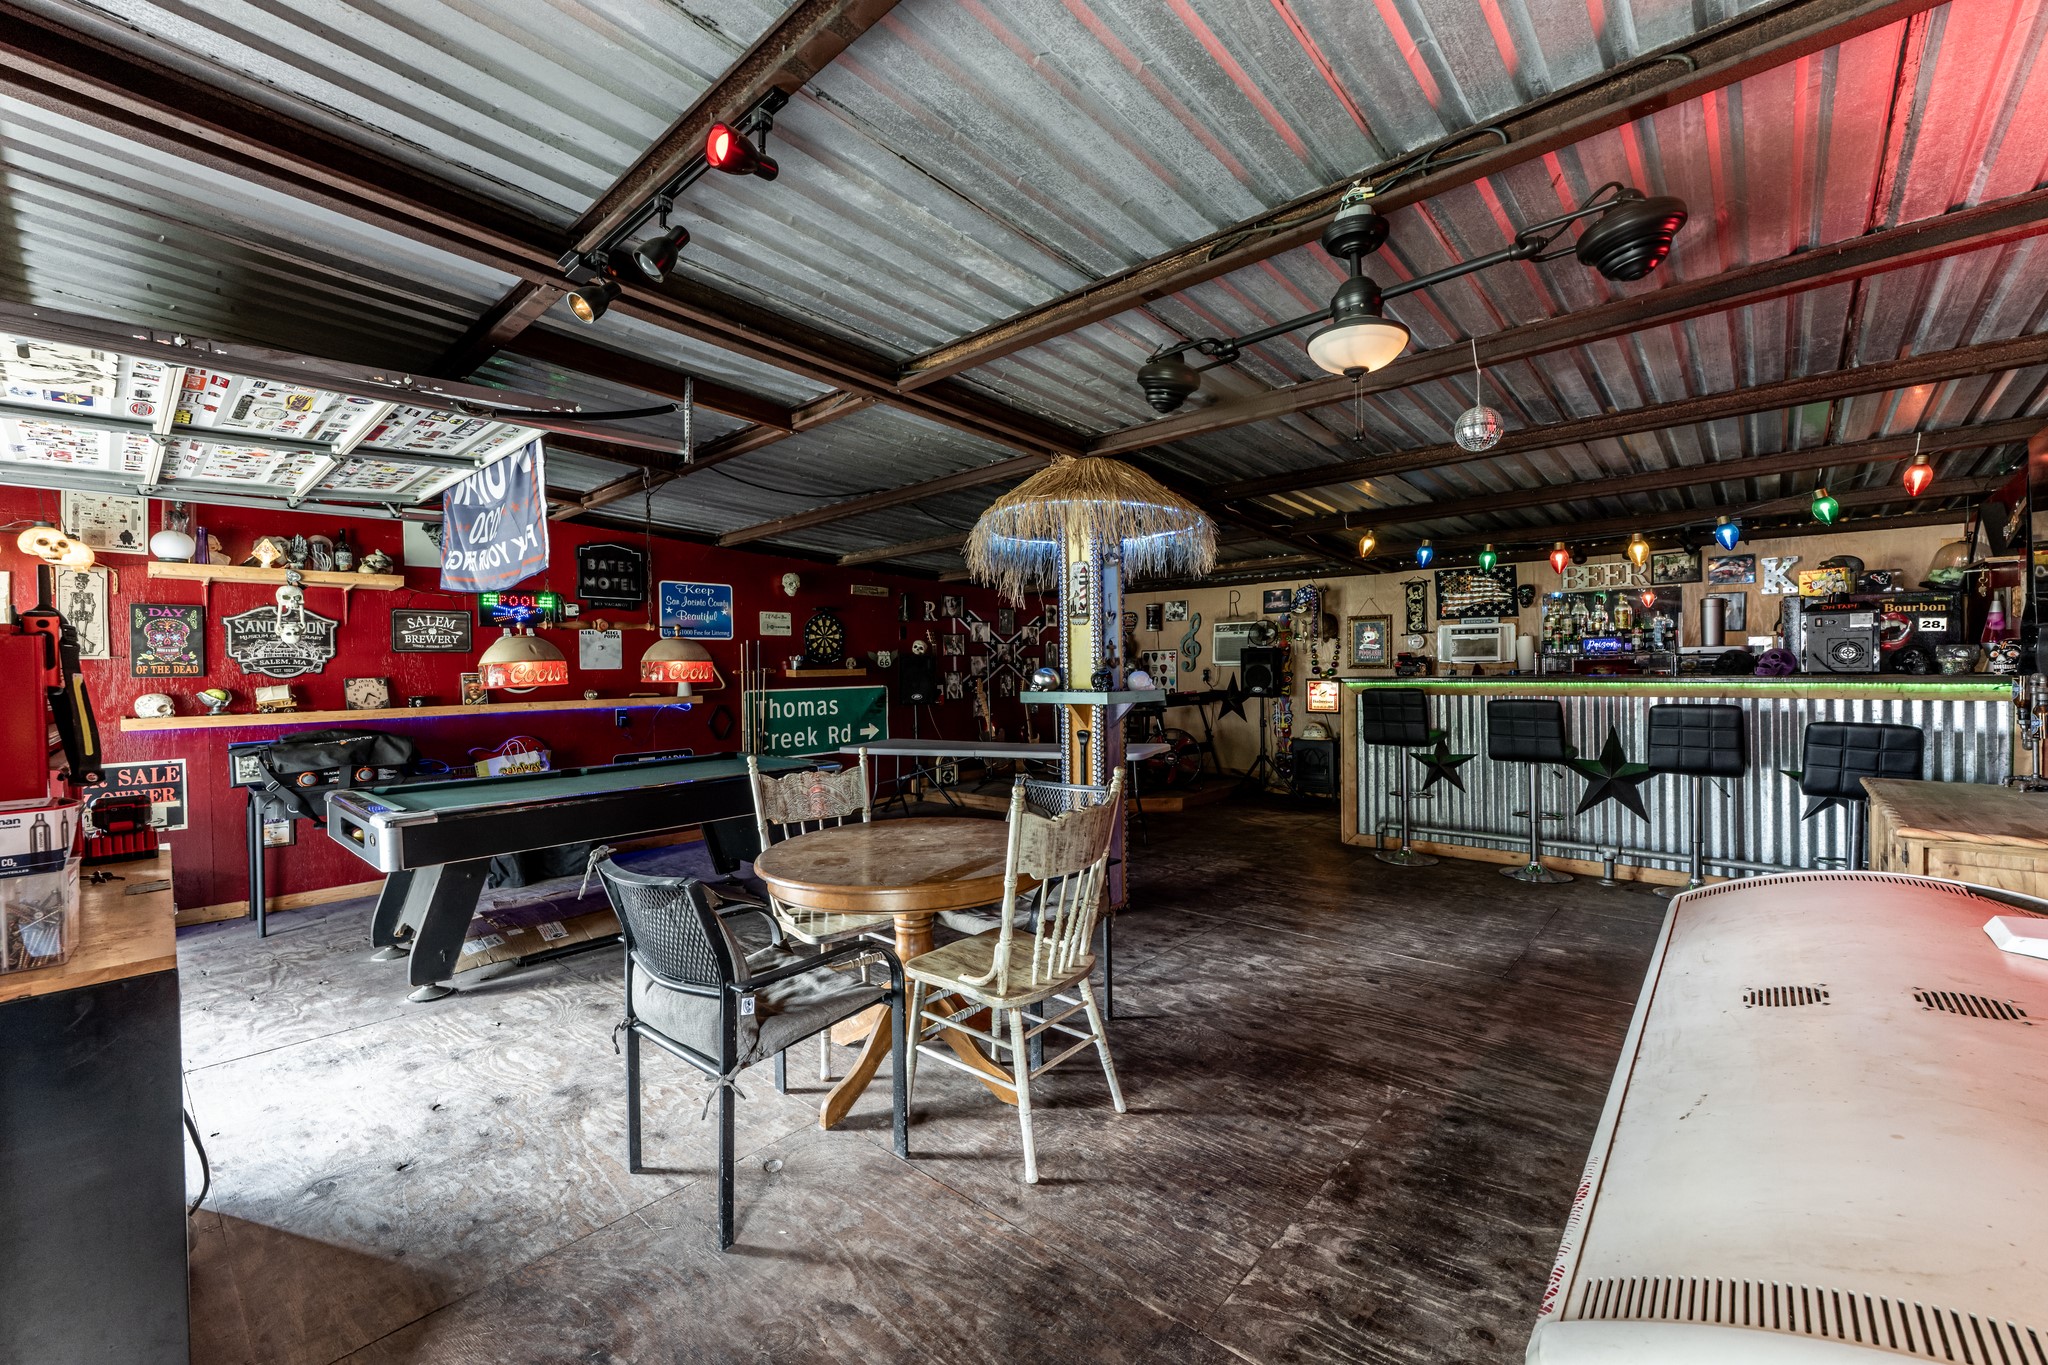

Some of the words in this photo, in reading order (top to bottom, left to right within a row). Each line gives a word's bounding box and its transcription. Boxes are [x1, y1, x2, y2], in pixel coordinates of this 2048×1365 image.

[587, 558, 633, 573] BATES
[1561, 561, 1651, 590] BEER
[1760, 555, 1799, 595] K
[583, 577, 637, 592] MOTEL
[675, 584, 715, 596] Keep
[498, 595, 539, 607] POOL
[665, 595, 680, 606] San
[681, 595, 707, 607] Jacinto
[708, 597, 729, 610] County
[1884, 602, 1947, 613] Bourbon
[148, 607, 186, 618] DAY
[675, 609, 718, 624] Beautiful
[406, 615, 457, 630] SALEM
[404, 634, 460, 644] BREWERY
[879, 657, 890, 667] 66
[135, 665, 148, 675] OF
[150, 665, 171, 674] THE
[173, 665, 199, 674] DEAD
[507, 663, 562, 685] Coors
[668, 662, 709, 680] Coors
[828, 723, 852, 745] Rd
[117, 765, 181, 787] SALE
